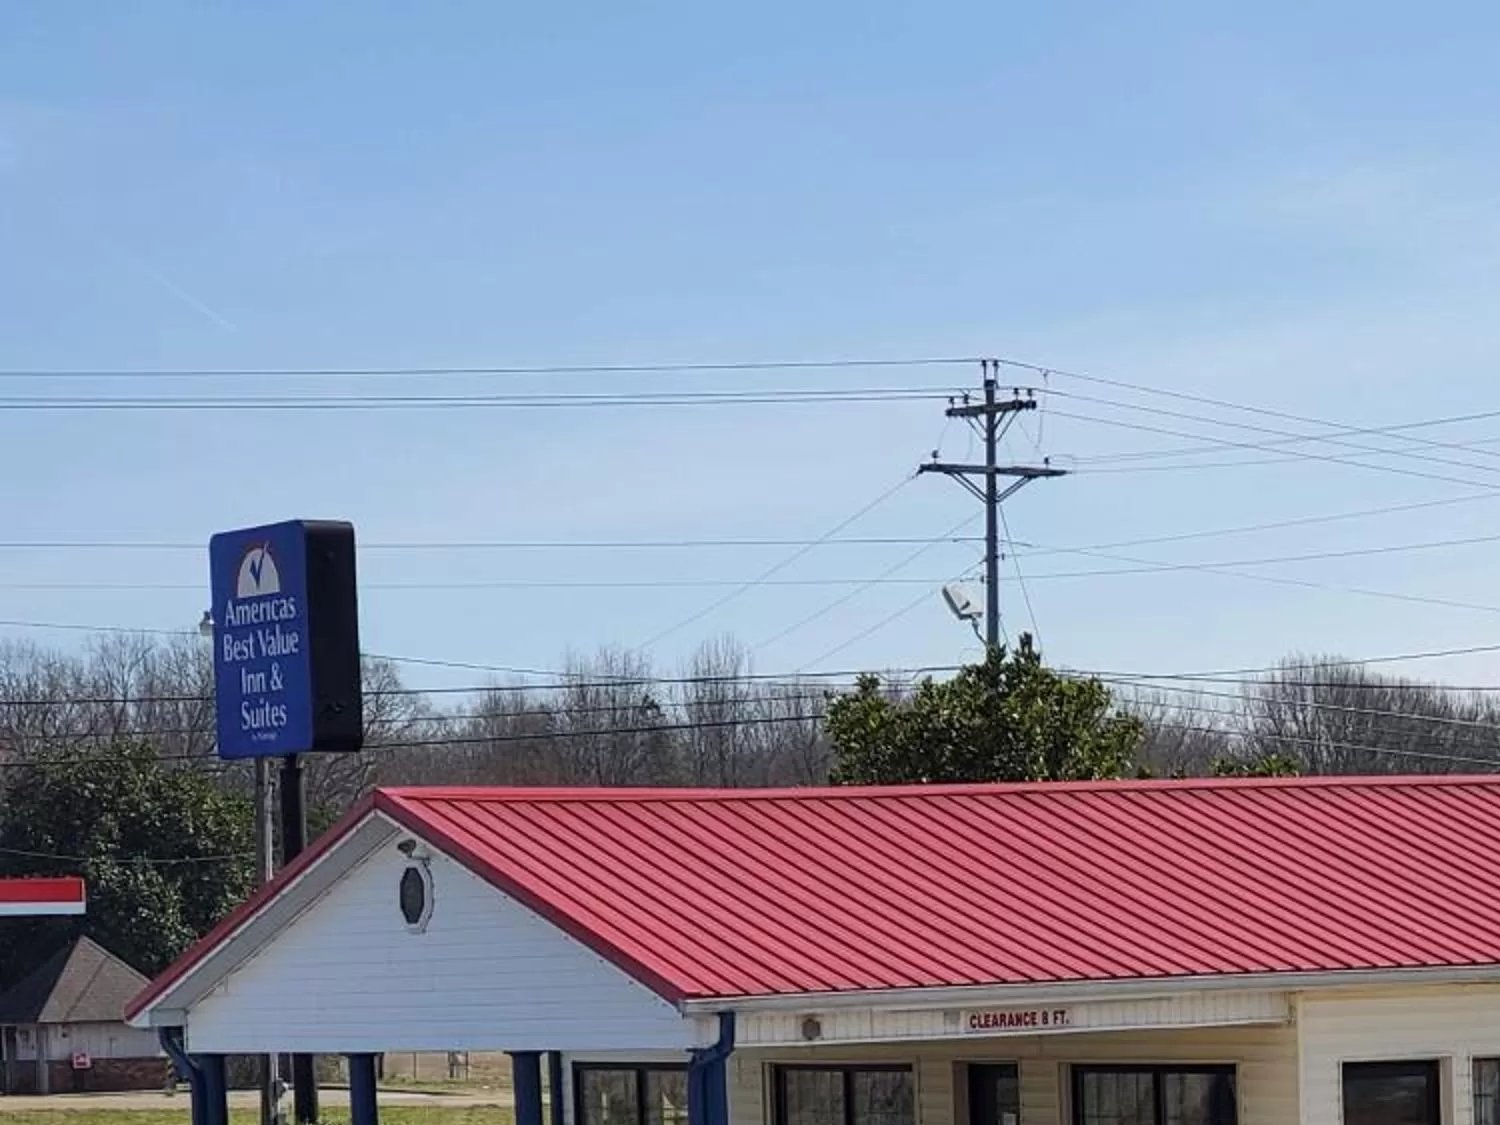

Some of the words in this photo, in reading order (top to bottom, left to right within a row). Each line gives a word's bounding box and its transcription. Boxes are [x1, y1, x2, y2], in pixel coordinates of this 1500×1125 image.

[225, 597, 297, 628] Americas
[223, 632, 255, 662] Best
[257, 624, 299, 657] Value
[241, 667, 266, 694] Inn
[270, 662, 283, 691] &
[241, 698, 287, 730] Suites
[969, 1012, 1038, 1028] CLEARANCE
[1053, 1010, 1070, 1025] FT.
